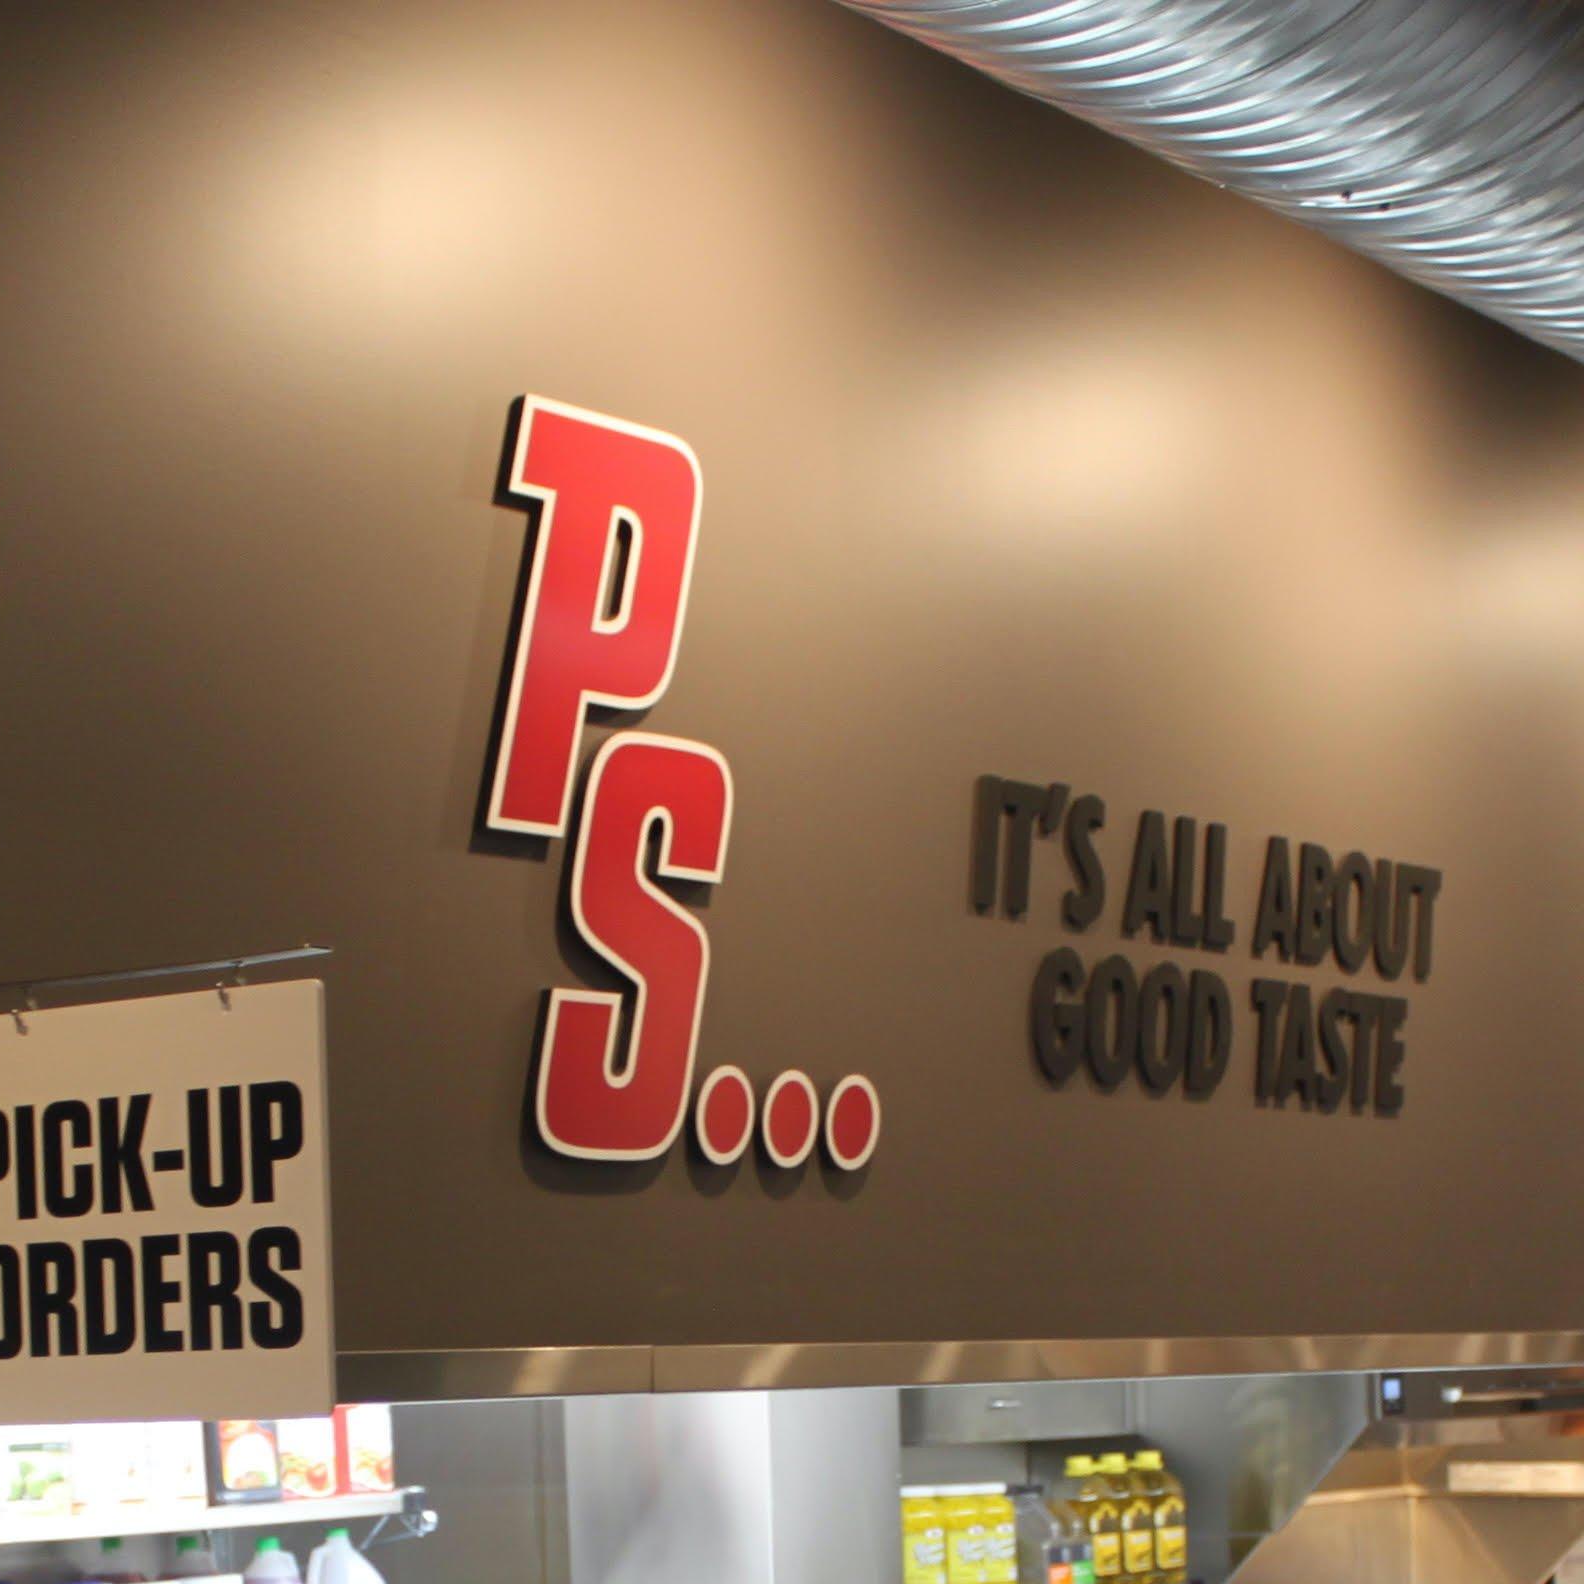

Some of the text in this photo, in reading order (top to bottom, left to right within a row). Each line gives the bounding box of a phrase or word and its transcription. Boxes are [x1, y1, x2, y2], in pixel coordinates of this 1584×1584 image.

[970, 774, 1442, 982] IT'S ALL ABOUT
[1031, 946, 1408, 1119] GOOD TASTE
